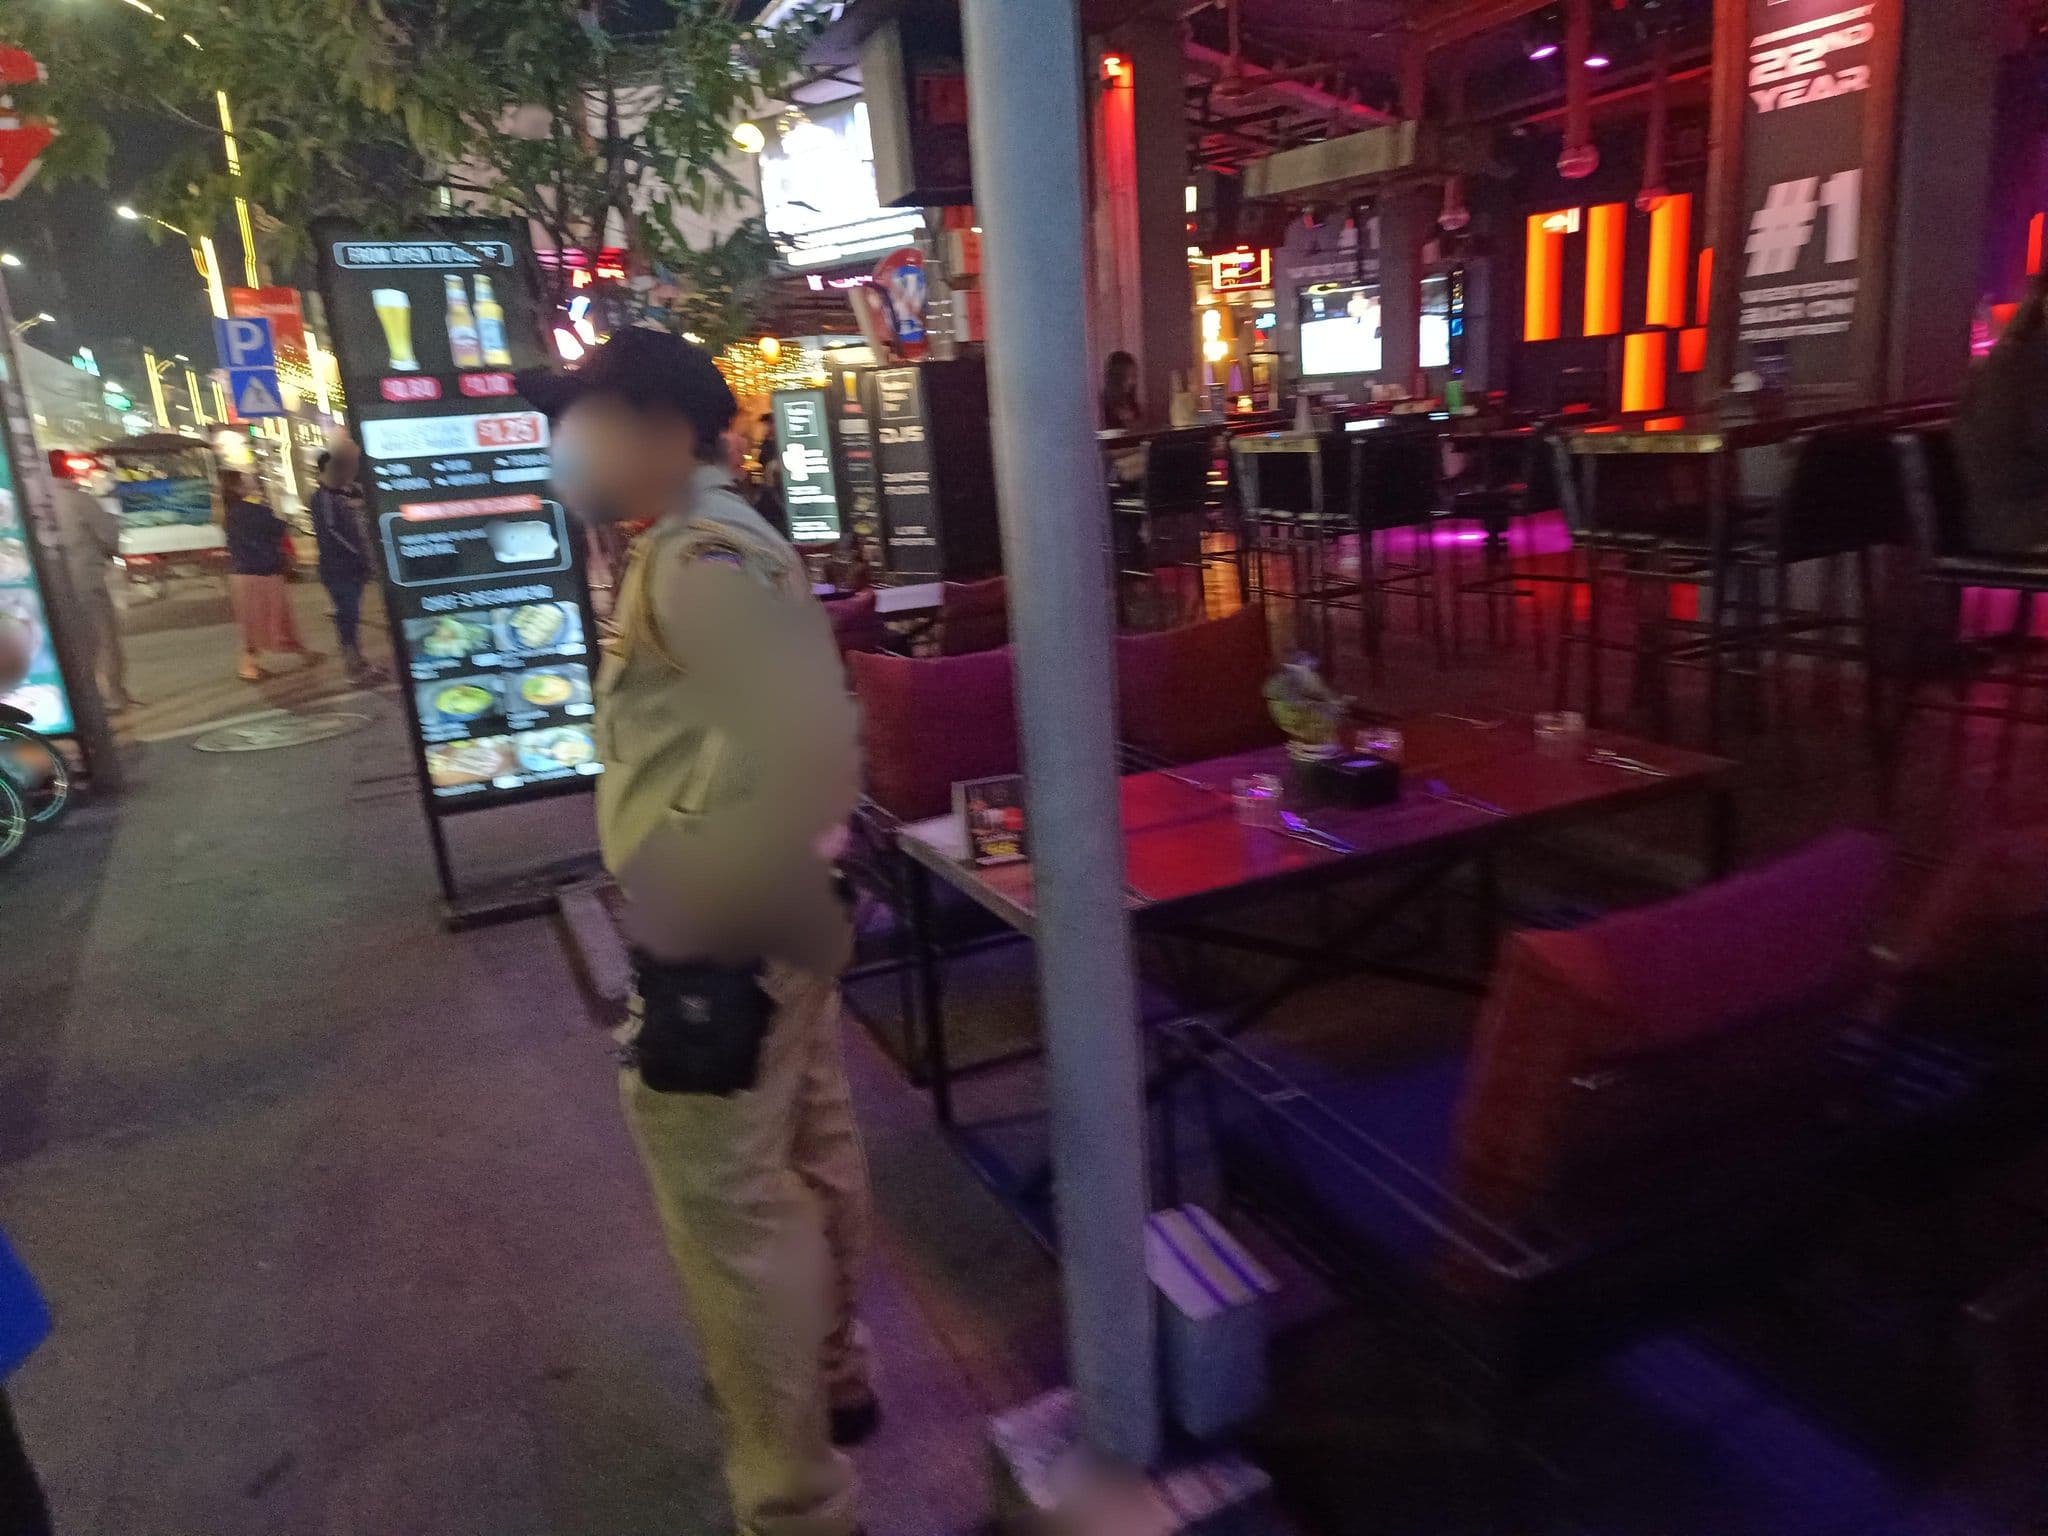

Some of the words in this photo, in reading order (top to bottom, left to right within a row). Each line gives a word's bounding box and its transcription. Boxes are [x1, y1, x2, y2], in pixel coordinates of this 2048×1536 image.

[1749, 65, 1872, 114] YEAR
[1744, 168, 1863, 278] #1
[226, 320, 264, 366] P
